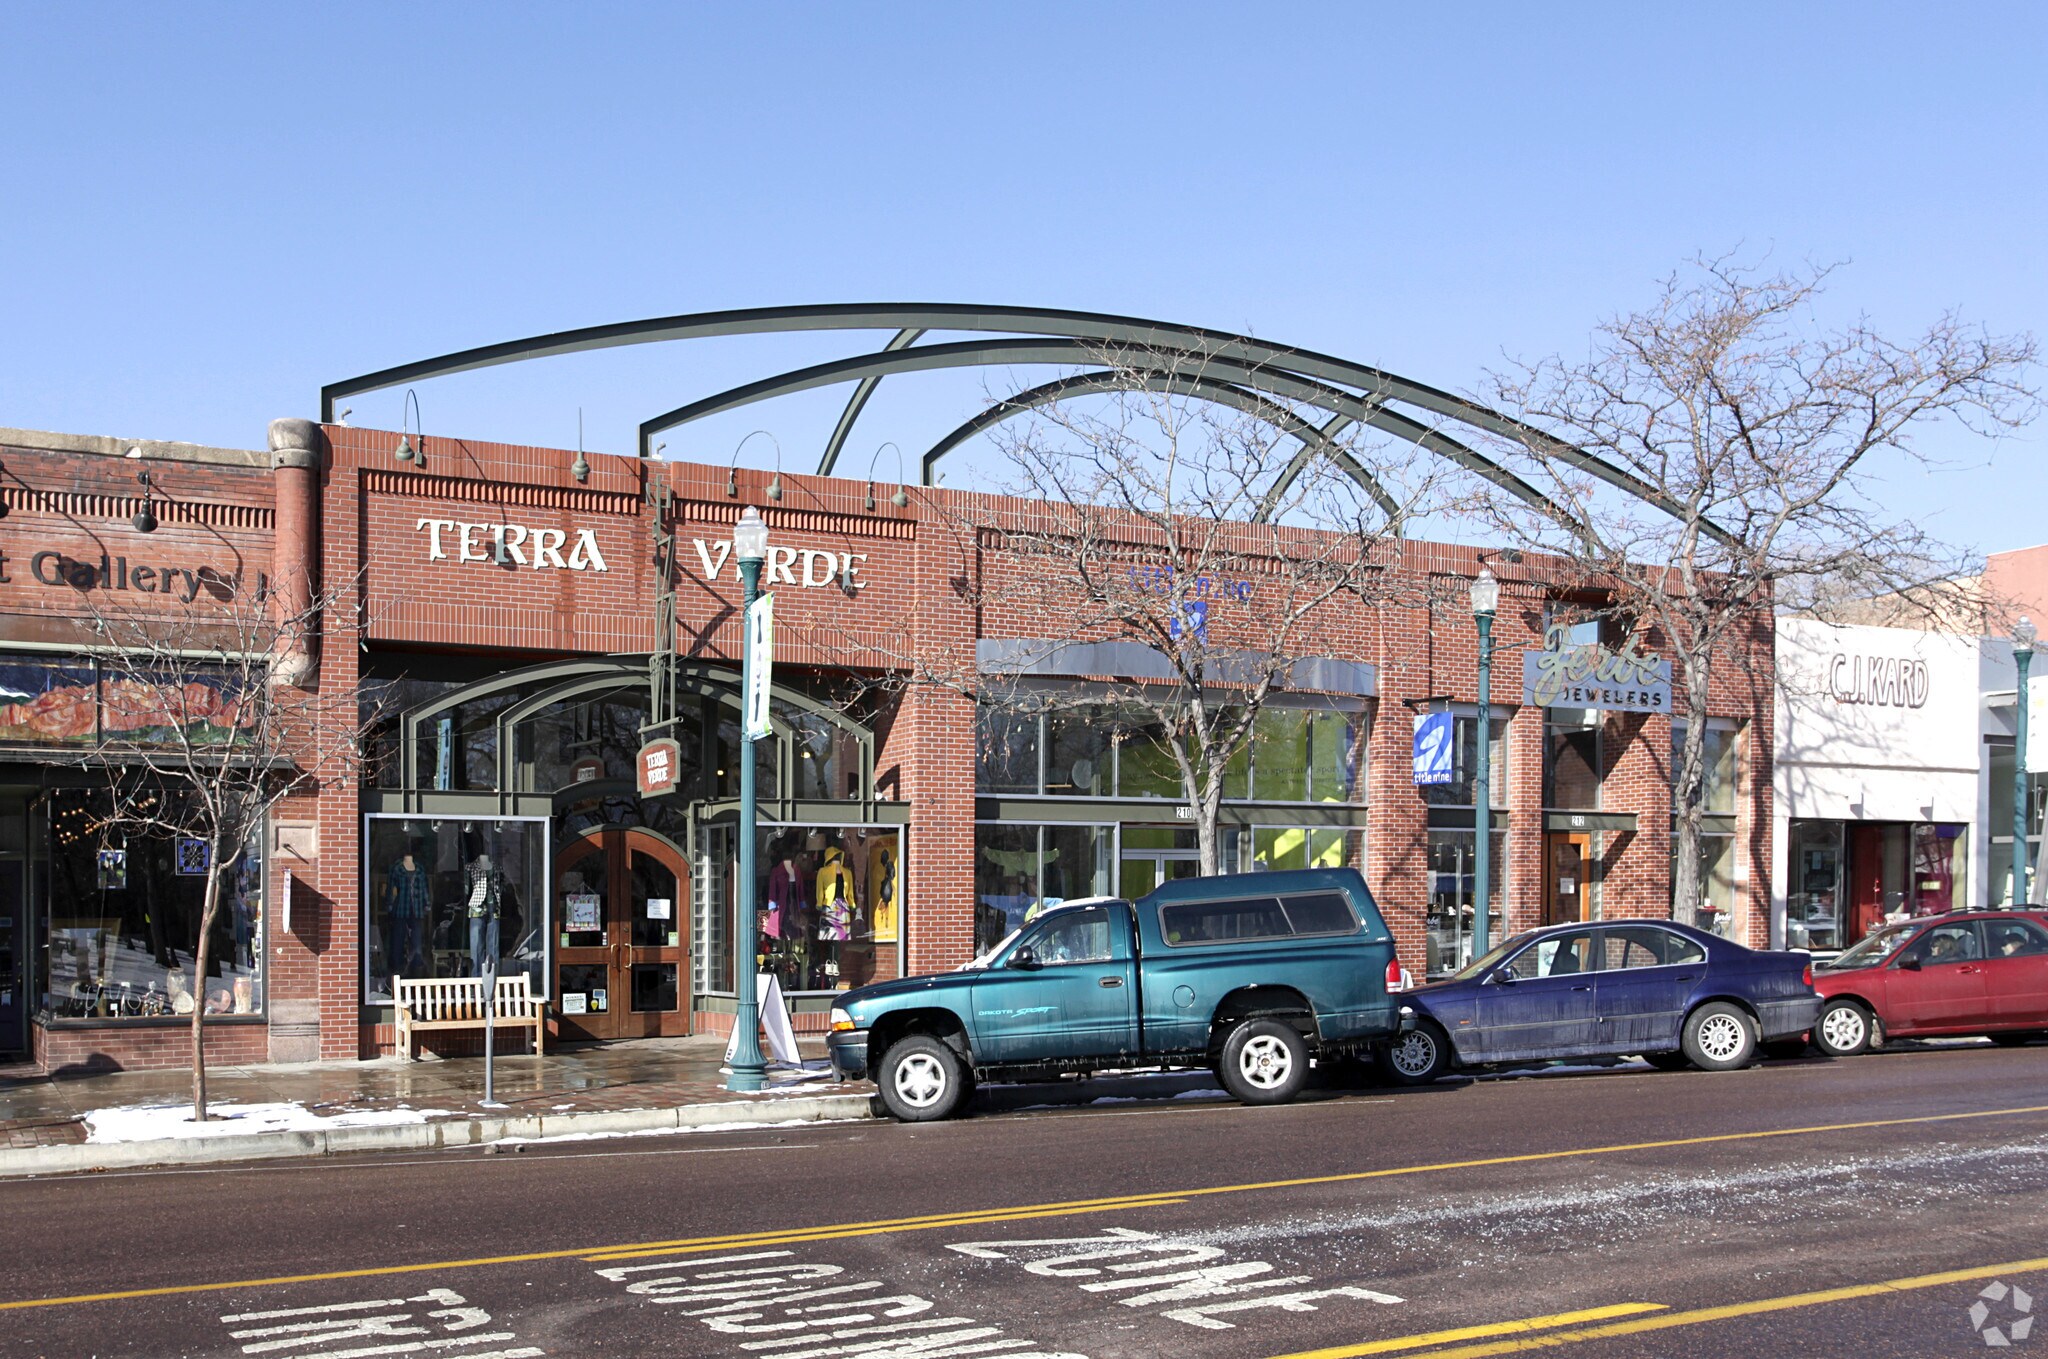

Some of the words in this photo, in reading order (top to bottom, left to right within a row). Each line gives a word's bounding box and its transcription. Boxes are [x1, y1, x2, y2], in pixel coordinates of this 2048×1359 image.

[416, 518, 609, 572] TERRA
[692, 538, 868, 590] VRDE
[31, 550, 202, 604] Gallery
[1533, 623, 1661, 707] Zerbe
[1867, 656, 1930, 709] KARD
[1563, 686, 1663, 706] JEWELERS
[646, 749, 669, 769] TERRA
[647, 766, 668, 785] VERDE
[1414, 772, 1432, 783] title
[1433, 771, 1450, 782] nine
[1177, 807, 1191, 818] 210
[1011, 1006, 1059, 1018] SPORT
[944, 1226, 1407, 1330] ZONE
[594, 1249, 1090, 1359] LOADIN
